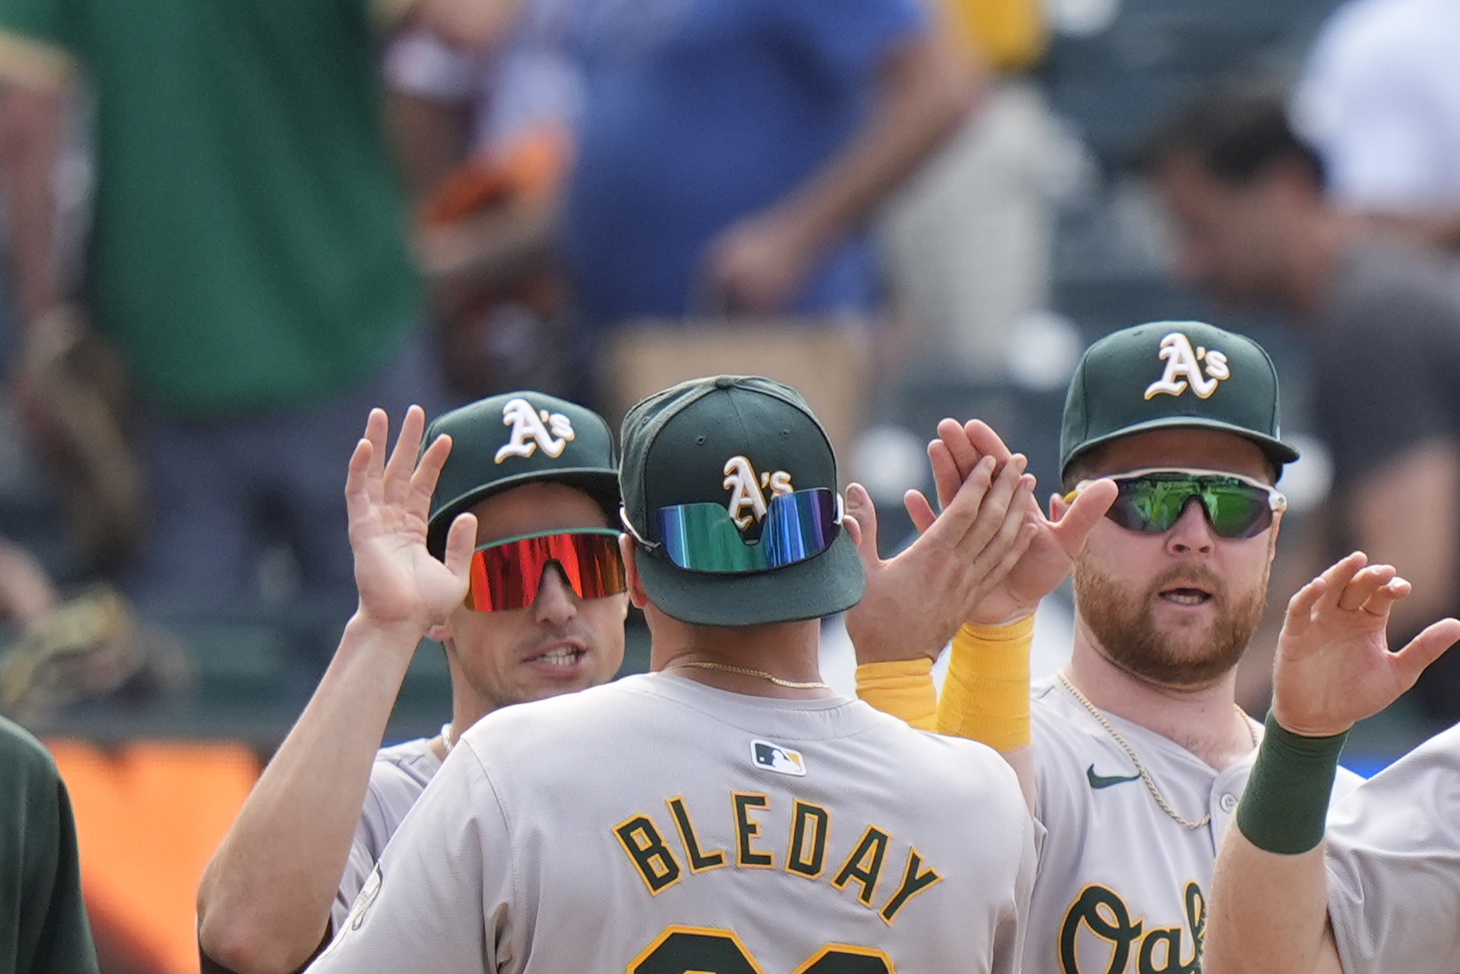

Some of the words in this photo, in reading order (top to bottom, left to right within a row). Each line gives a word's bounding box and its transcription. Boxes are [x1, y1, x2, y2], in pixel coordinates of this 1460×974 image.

[1143, 331, 1231, 401] A's
[494, 397, 575, 465] A's
[722, 454, 796, 533] A's
[611, 790, 943, 926] BLEDAY
